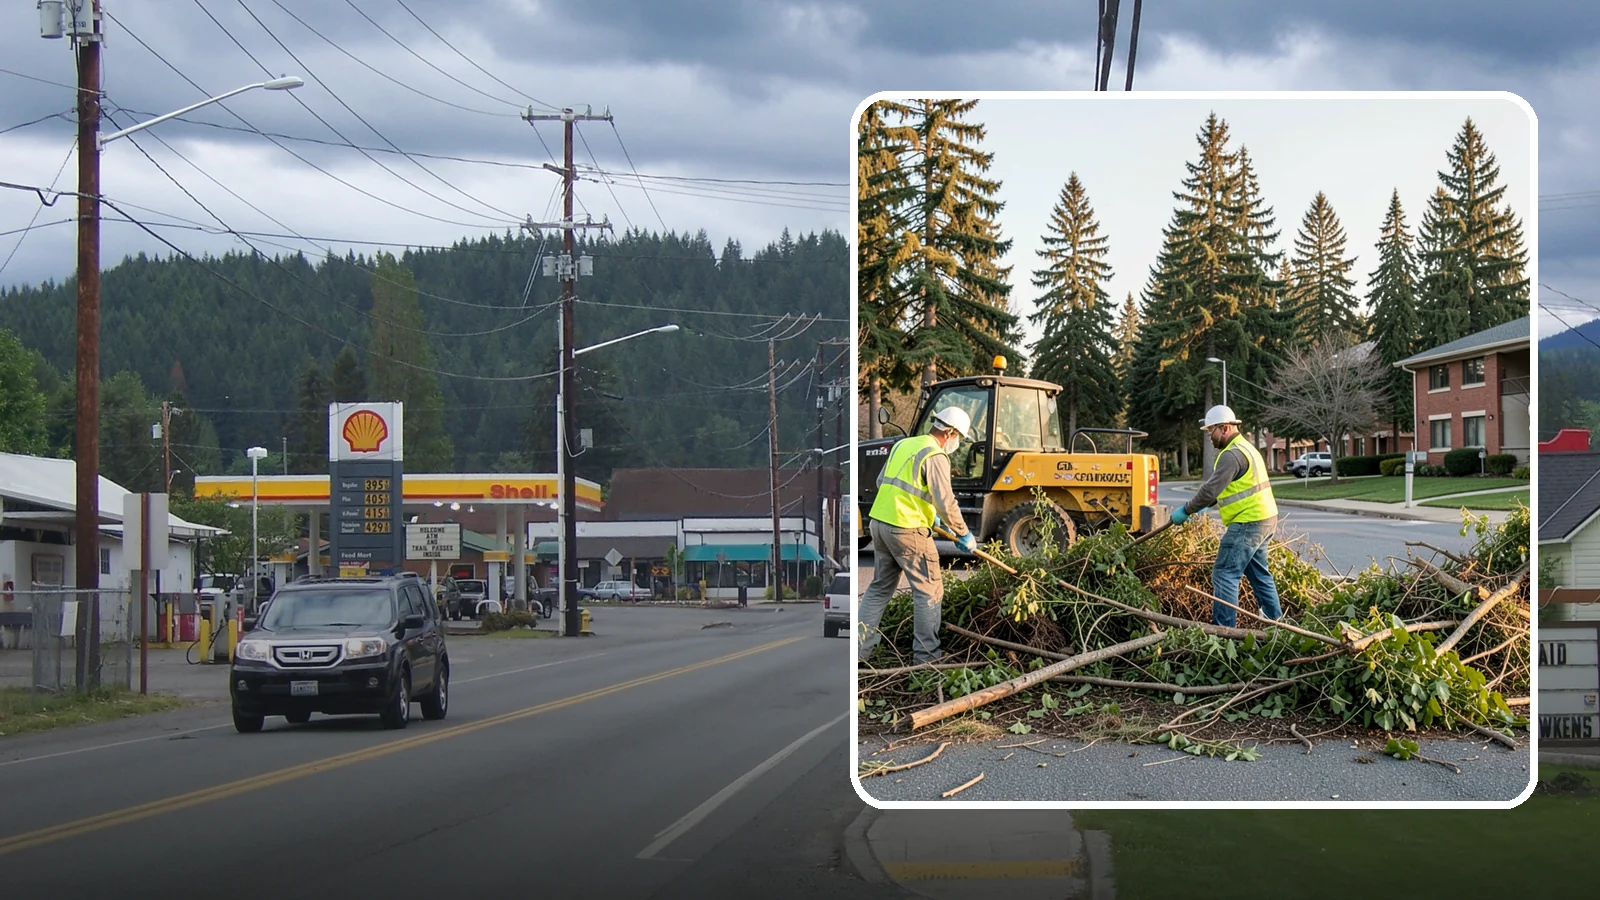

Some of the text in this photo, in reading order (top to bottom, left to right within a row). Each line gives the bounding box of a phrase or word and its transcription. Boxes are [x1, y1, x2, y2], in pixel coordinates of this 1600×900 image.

[366, 480, 383, 490] 395
[490, 484, 547, 499] Shell
[366, 494, 383, 504] 405
[366, 508, 383, 518] 415
[366, 522, 383, 532] 429
